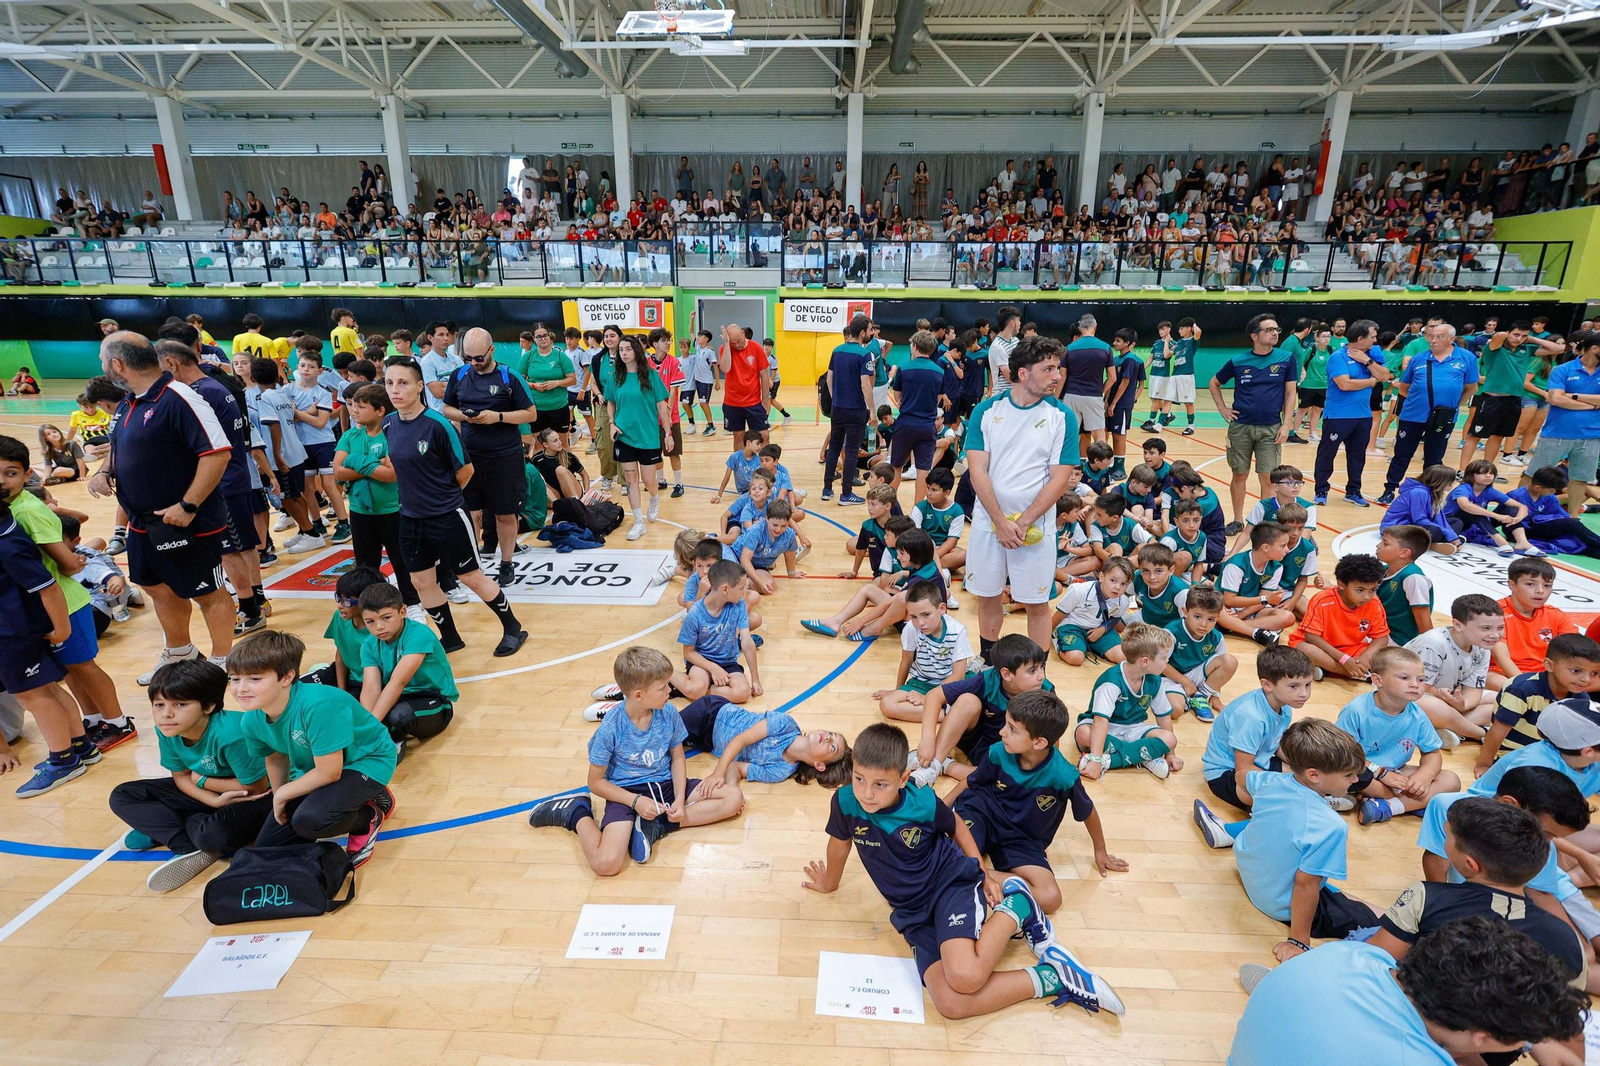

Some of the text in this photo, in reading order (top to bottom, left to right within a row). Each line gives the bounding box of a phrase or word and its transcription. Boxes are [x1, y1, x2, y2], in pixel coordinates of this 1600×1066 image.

[584, 303, 630, 312] CONCELLO
[790, 304, 838, 314] CONCELLO
[591, 312, 626, 321] DE VIGO
[795, 314, 832, 323] DE VIGO
[334, 335, 340, 351] 4
[156, 539, 188, 551] adidas
[568, 562, 619, 573] DE
[862, 987, 890, 995] CORUXO
